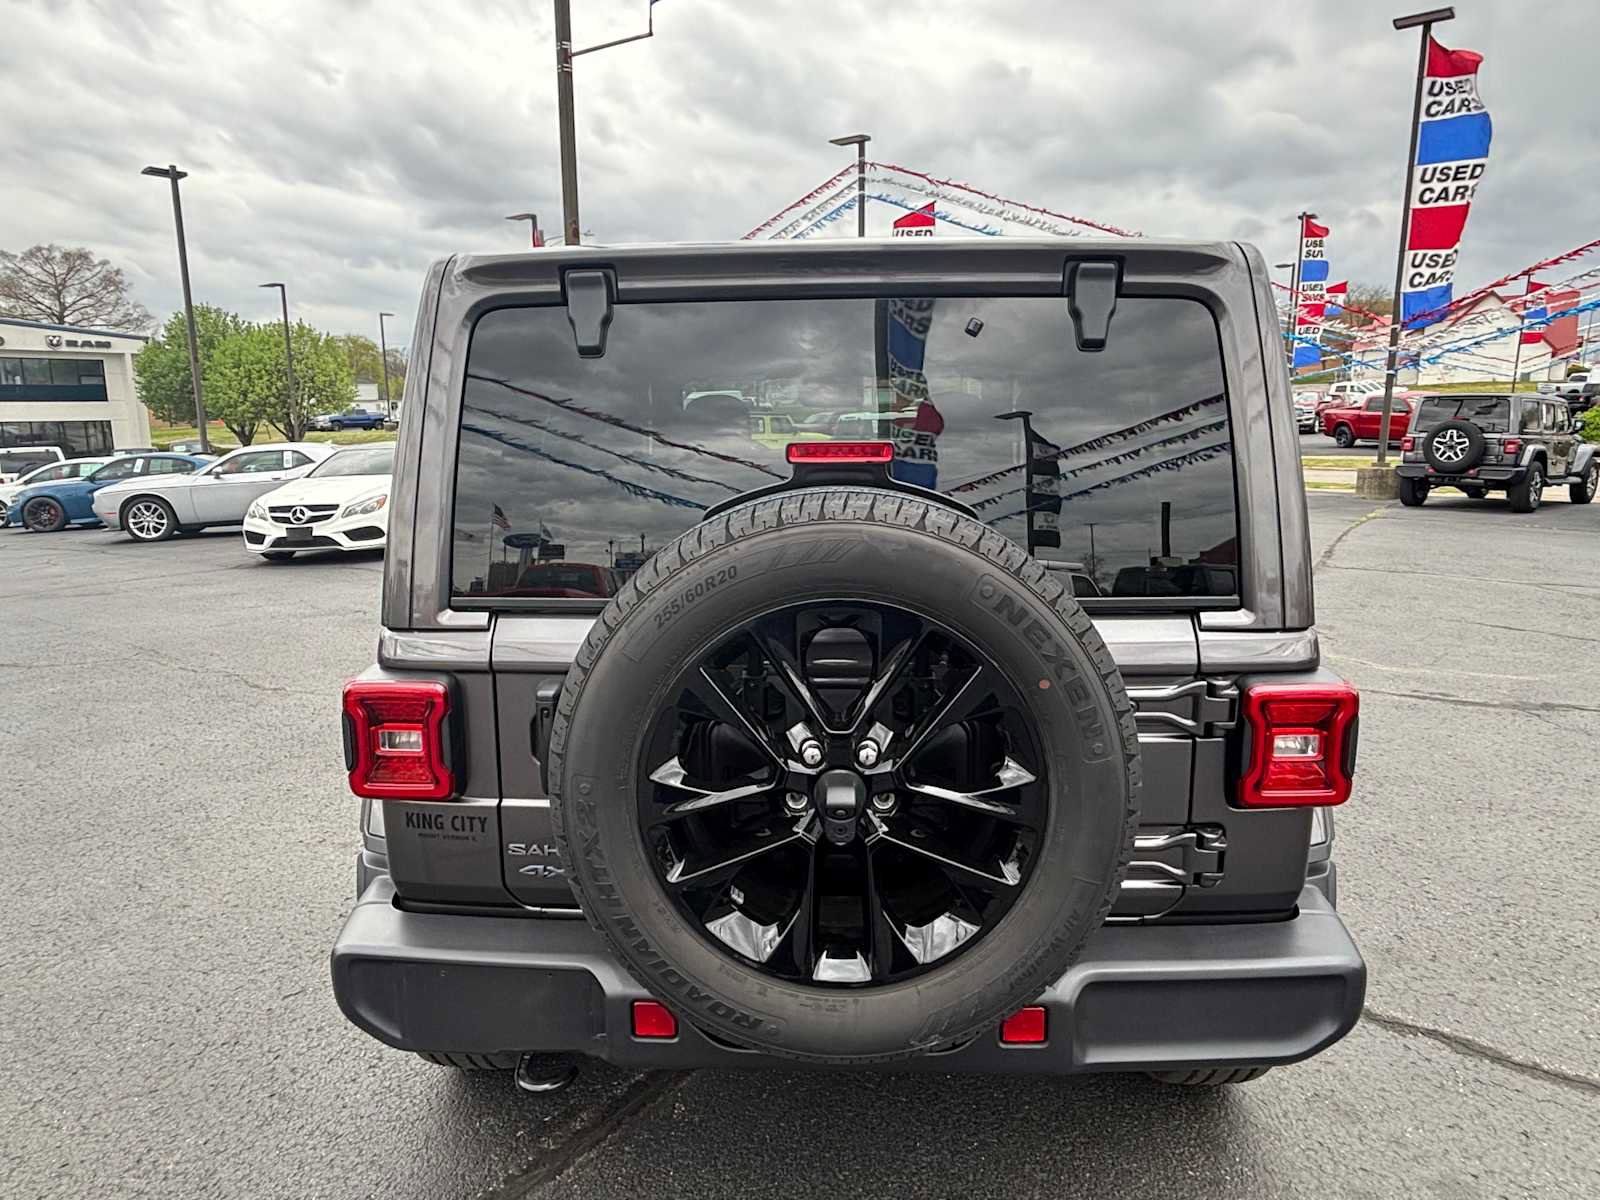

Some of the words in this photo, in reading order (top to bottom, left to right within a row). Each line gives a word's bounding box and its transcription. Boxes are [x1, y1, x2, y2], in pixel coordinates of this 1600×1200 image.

[1420, 163, 1486, 184] USED
[654, 565, 737, 629] 255/60R20
[993, 593, 1105, 740] NEXEN
[405, 811, 444, 830] KING
[451, 815, 488, 833] CITY
[508, 843, 560, 857] SAH
